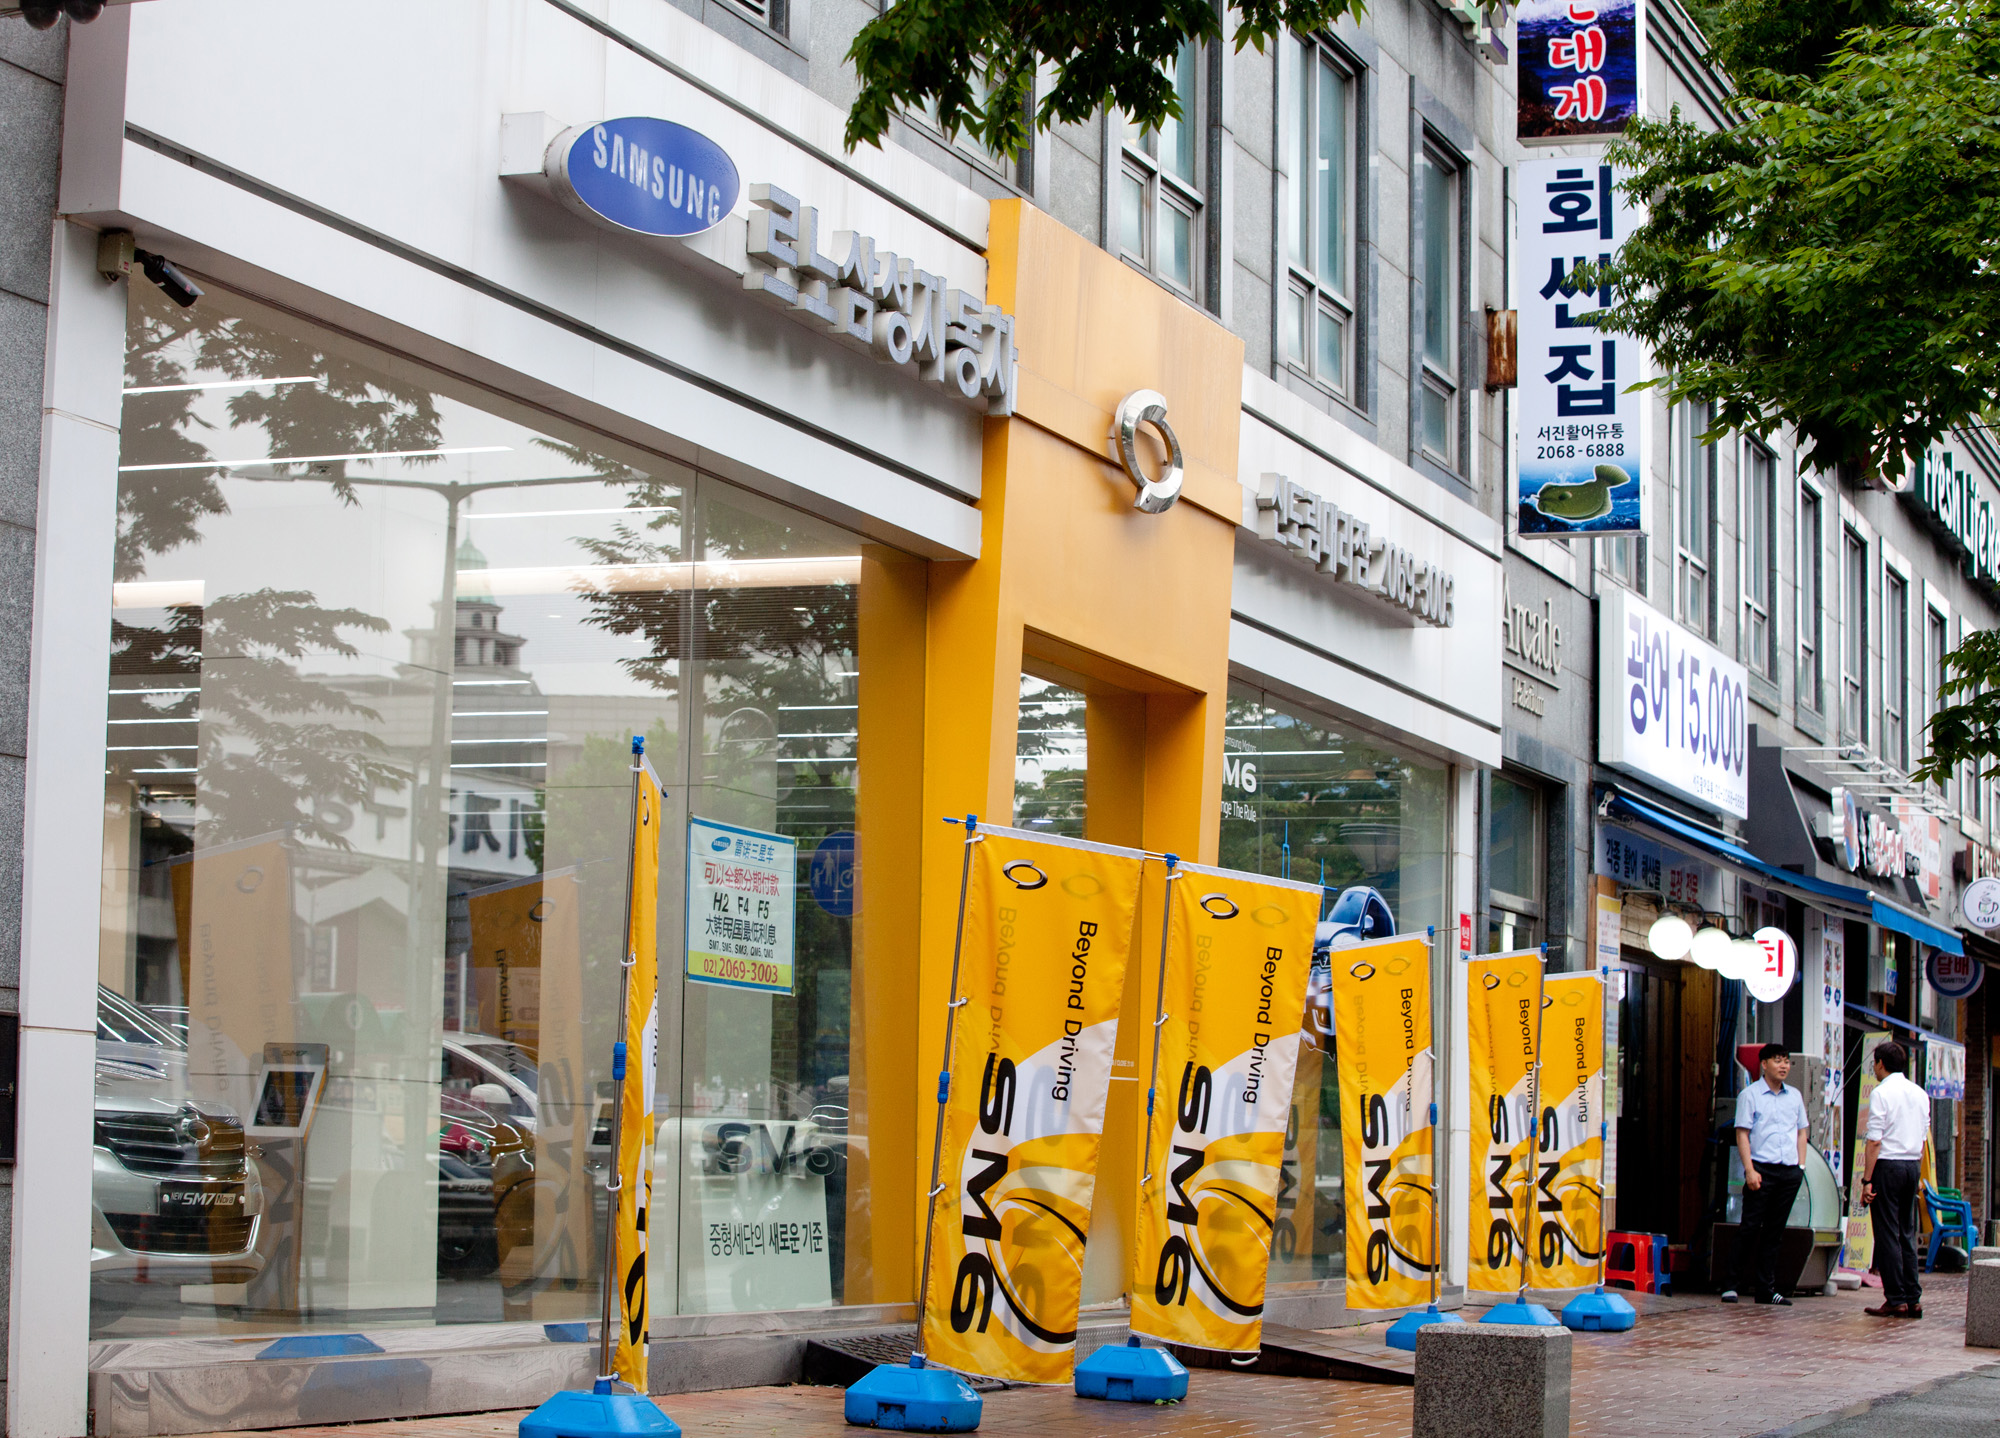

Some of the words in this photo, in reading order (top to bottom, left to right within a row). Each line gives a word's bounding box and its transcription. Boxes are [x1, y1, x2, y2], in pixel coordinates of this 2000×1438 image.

[593, 124, 722, 226] SAMSUNG
[1537, 423, 1625, 442] 서진활어유통
[1537, 443, 1625, 459] 2068-6888
[1923, 447, 1961, 539] Fresh
[1962, 470, 1988, 579] Life
[1258, 473, 1370, 590] 신도림대리점
[1369, 537, 1455, 629] 2069-3003
[1502, 573, 1562, 675] Arcade
[1627, 612, 1670, 749] 광어
[1677, 648, 1744, 777] 15,000
[1223, 754, 1257, 793] M6
[704, 862, 780, 897] 可以全额分期付款
[713, 892, 729, 913] H2
[738, 896, 749, 916] F4
[758, 899, 770, 920] F5
[705, 913, 777, 945] 大韩民国最低利息
[1068, 920, 1098, 1010] Beyond
[1256, 946, 1282, 1025] Beyond
[1937, 957, 1969, 976] 담배
[1400, 988, 1414, 1050] Beyond
[1519, 999, 1534, 1056] Beyond
[1575, 1017, 1587, 1070] Beyond
[1052, 1019, 1082, 1102] Driving
[1242, 1033, 1270, 1104] Driving
[1577, 1074, 1590, 1123] Driving
[171, 1192, 183, 1201] NEW
[182, 1193, 216, 1206] SM7
[216, 1193, 235, 1205] Nova
[950, 1053, 1016, 1334] SM6
[1155, 1061, 1212, 1306] SM6
[1360, 1093, 1391, 1286] SM6
[1487, 1094, 1514, 1270] SM6
[1537, 1106, 1564, 1269] SM6
[709, 1222, 766, 1257] 중형세단의
[768, 1222, 800, 1255] 새로운
[802, 1221, 824, 1254] 기준
